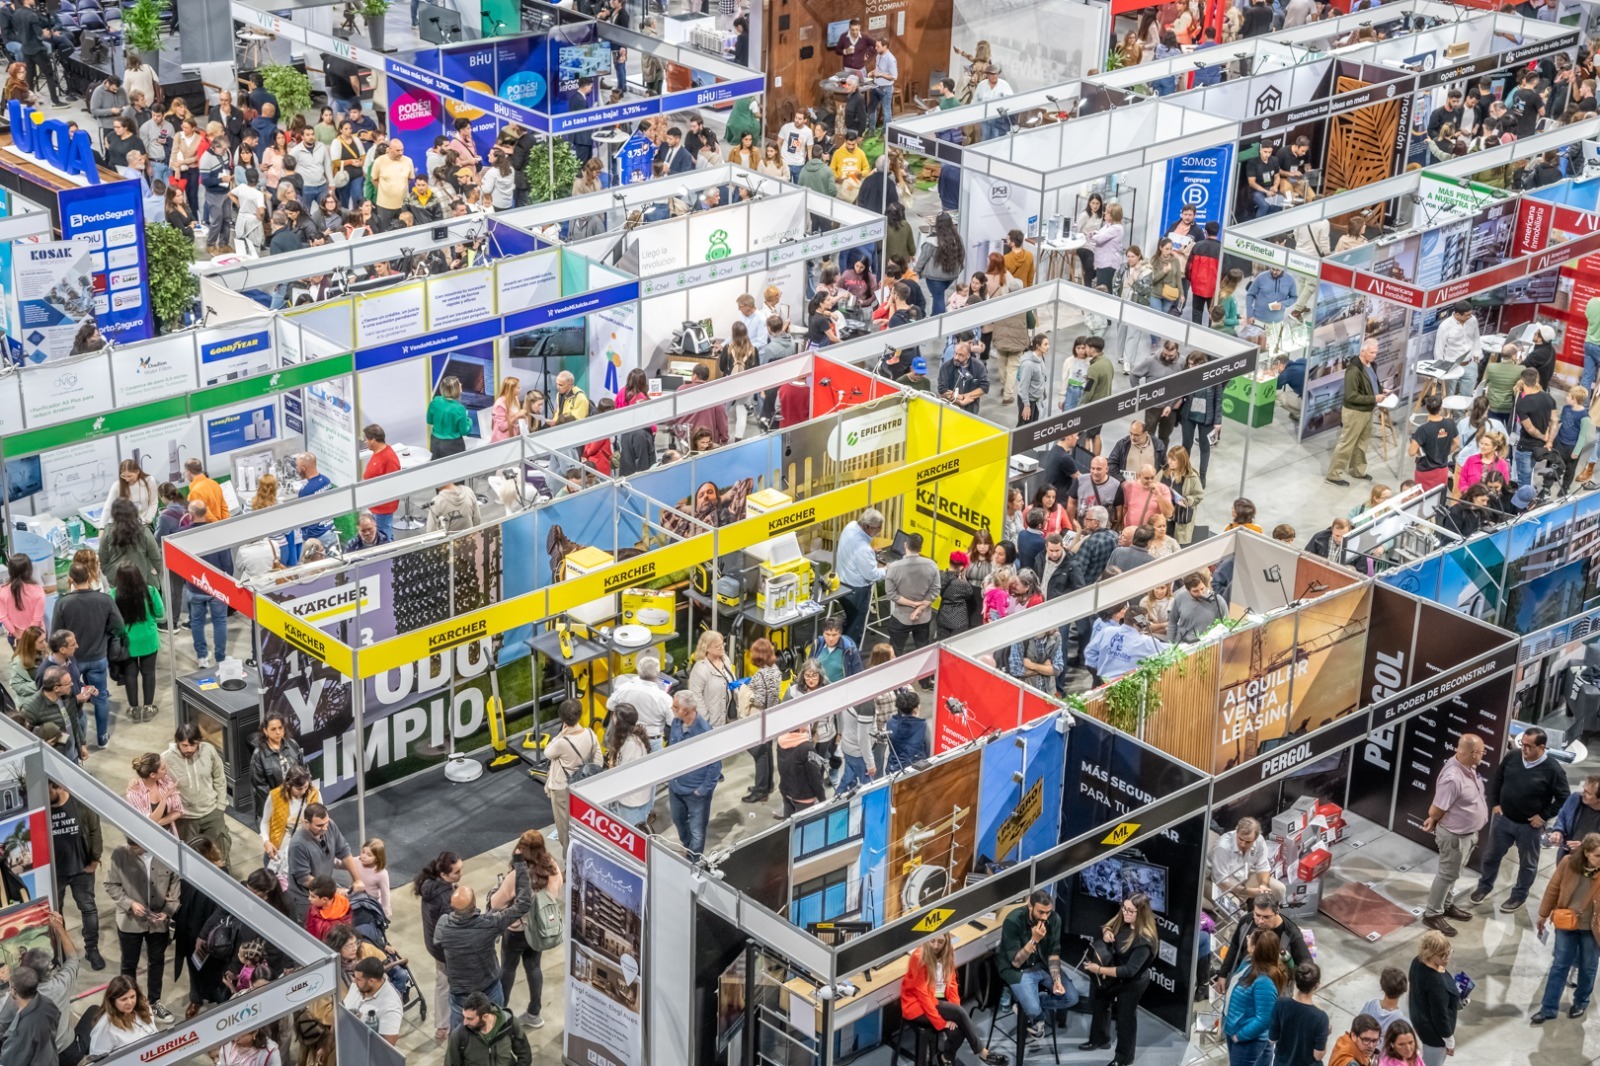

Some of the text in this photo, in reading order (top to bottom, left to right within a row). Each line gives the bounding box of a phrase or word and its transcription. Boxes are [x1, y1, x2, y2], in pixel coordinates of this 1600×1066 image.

[333, 40, 357, 61] VIVE
[469, 53, 493, 67] BHU
[1440, 64, 1475, 81] openHome
[507, 80, 538, 94] PODÉS!
[697, 90, 716, 104] BHU
[398, 98, 432, 114] PODÉS!
[1354, 93, 1370, 105] metal
[494, 103, 510, 117] BHU
[562, 118, 571, 128] ¡La
[572, 116, 588, 127] tasa
[588, 112, 603, 123] más
[603, 110, 619, 122] baja!
[622, 105, 641, 117] 3,75%
[1181, 157, 1217, 167] SOMOS
[1438, 187, 1454, 197] MÁS
[1522, 205, 1536, 248] Americana
[1531, 207, 1544, 250] Inmobiliaria
[30, 248, 72, 261] KOSAK
[641, 248, 660, 261] Llegó
[1245, 241, 1275, 258] Filmetal
[1384, 290, 1413, 304] Inmobiliaria
[1385, 283, 1414, 297] Americana
[1449, 281, 1470, 293] Americana
[209, 338, 259, 356] GOODYEAR
[409, 334, 459, 352] VendoMiJuicio.com
[1202, 359, 1247, 381] ECOFLOW
[1117, 386, 1165, 411] ECOFLOW
[860, 418, 902, 438] EPICENTRO
[1033, 416, 1081, 440] ECOFLOW
[917, 458, 960, 481] KÄRCHER
[768, 507, 816, 534] KÄRCHER
[916, 488, 992, 534] KÄRCHER
[604, 561, 656, 588] KÄRCHER
[293, 586, 368, 617] KÄRCHER
[284, 621, 326, 656] KÄRCHER
[428, 619, 487, 650] KÄRCHER
[1223, 659, 1309, 710] ALQUILER
[1384, 706, 1396, 719] EL
[1397, 694, 1426, 714] PODER
[1427, 687, 1439, 701] DE
[1440, 660, 1497, 697] RECONSTRUIR
[1223, 692, 1278, 727] VENTA
[1222, 702, 1295, 745] LEASING
[1080, 760, 1109, 783] MÁS
[1261, 742, 1313, 780] PERGOL
[1080, 782, 1111, 808] PARA
[60, 817, 76, 827] NOT
[581, 808, 635, 852] ACSA
[1113, 825, 1129, 840] ML
[924, 911, 942, 928] ML
[290, 979, 309, 994] UBK
[140, 1030, 200, 1062] ULBRIKA
